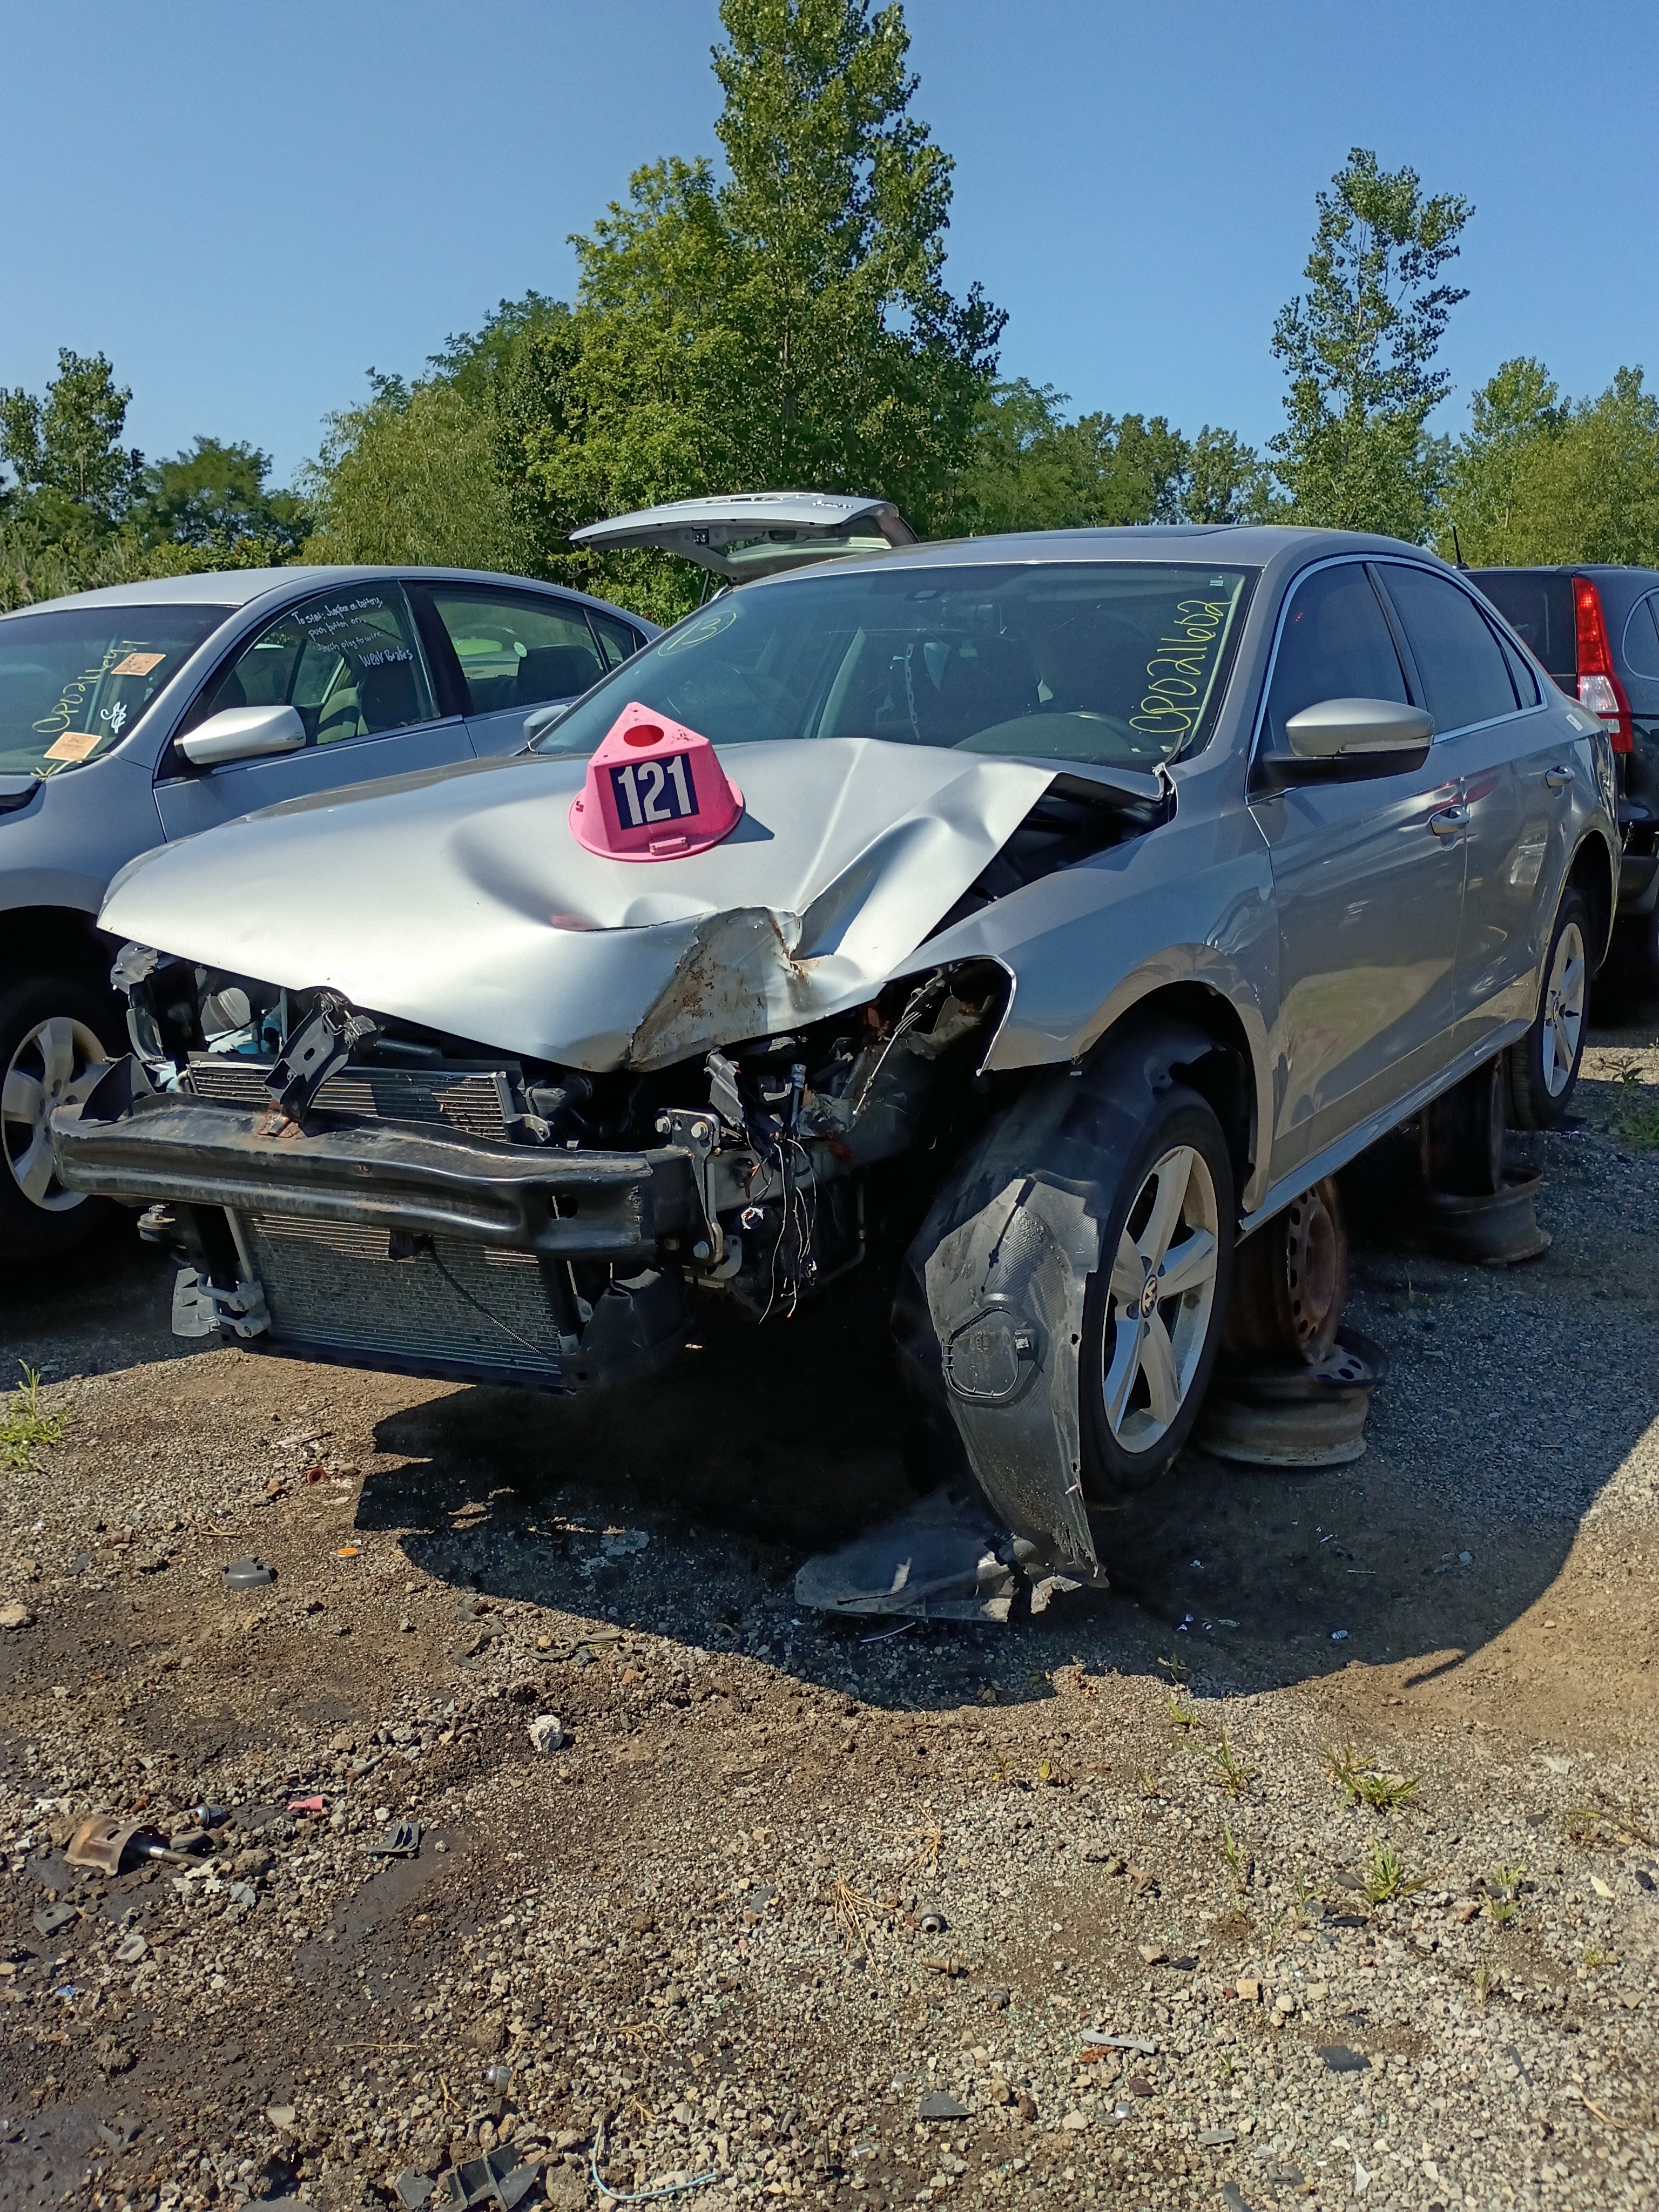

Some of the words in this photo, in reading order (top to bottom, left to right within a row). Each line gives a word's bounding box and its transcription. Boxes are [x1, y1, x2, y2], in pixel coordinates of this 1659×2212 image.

[291, 611, 305, 625] To
[308, 628, 327, 641] push
[327, 622, 349, 635] button
[341, 639, 358, 653] plug
[364, 631, 383, 642] wire
[666, 618, 721, 650] 13
[359, 650, 384, 667] Weak
[384, 645, 414, 662] Brakes
[1129, 600, 1232, 733] CP021602
[617, 756, 692, 825] 121
